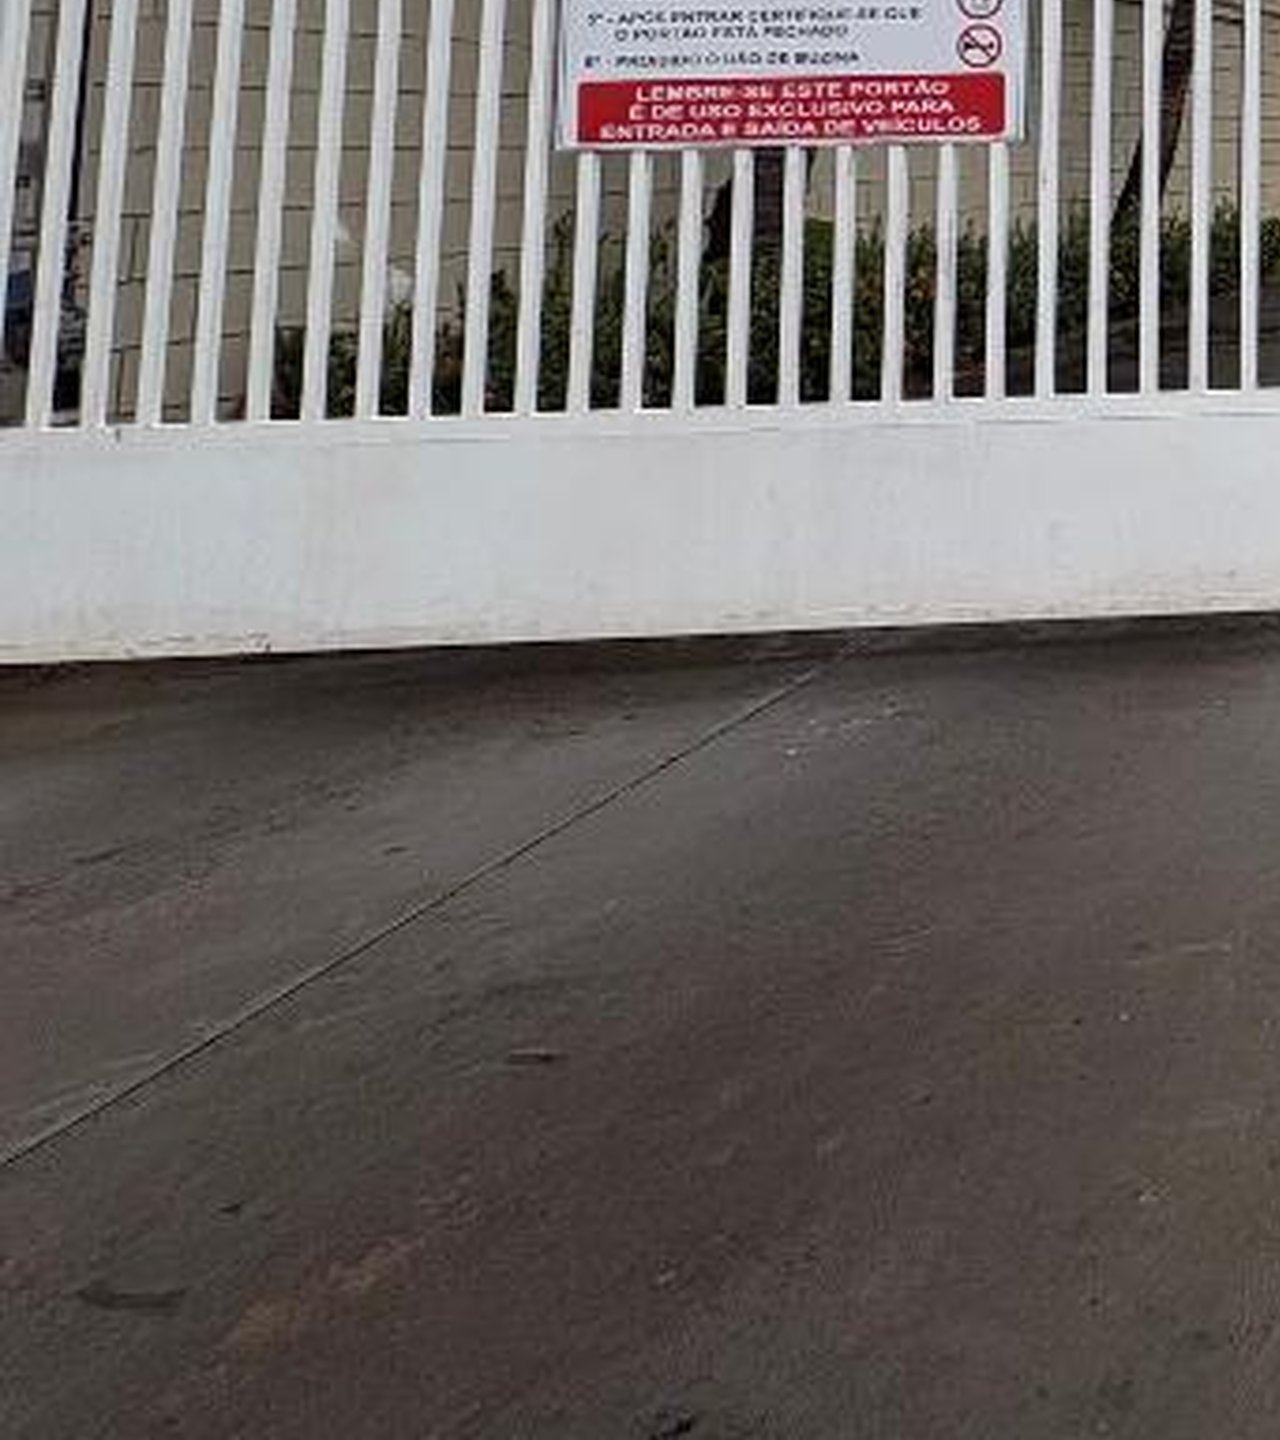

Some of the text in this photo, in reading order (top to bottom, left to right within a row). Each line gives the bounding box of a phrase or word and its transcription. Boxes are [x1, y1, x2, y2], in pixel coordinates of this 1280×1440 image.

[781, 81, 843, 99] ESTE
[651, 104, 684, 121] DE
[599, 121, 717, 140] ENTRADA
